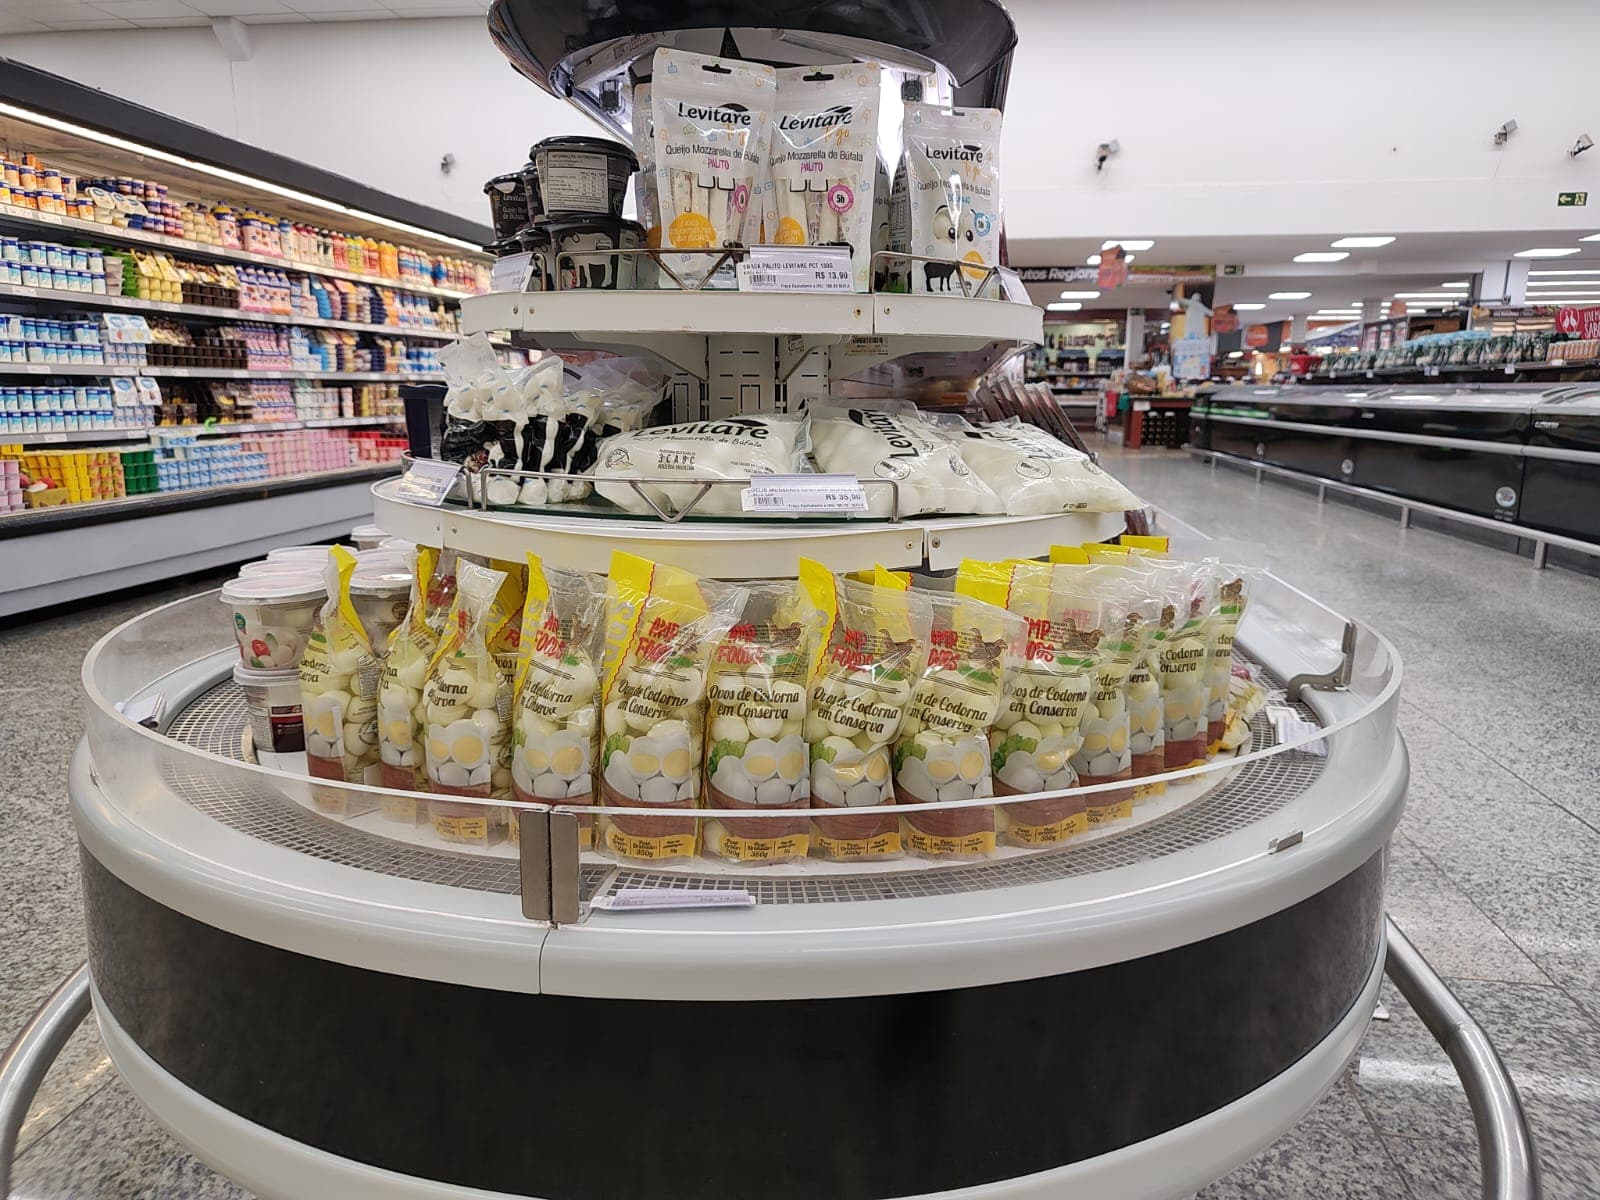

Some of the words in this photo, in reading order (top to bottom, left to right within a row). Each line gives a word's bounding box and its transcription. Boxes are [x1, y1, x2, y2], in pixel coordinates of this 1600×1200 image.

[678, 102, 750, 126] Levitare
[780, 106, 852, 130] Levitare
[665, 144, 691, 155] Queijo
[692, 145, 732, 157] Mozzarella
[788, 150, 827, 161] Mozzarella
[828, 150, 838, 160] de
[926, 145, 984, 163] Levitare
[708, 158, 730, 170] PALITO
[801, 162, 823, 174] PALITO
[815, 271, 826, 280] R$
[1018, 268, 1048, 280] utos
[632, 418, 770, 440] Levitare
[1165, 647, 1204, 661] Codorna
[642, 685, 689, 707] Codorna
[709, 685, 735, 700] Ovos
[736, 688, 752, 701] de
[753, 688, 800, 703] Codorna
[1028, 686, 1044, 699] de
[1045, 686, 1087, 702] Codorna
[717, 704, 734, 717] em
[736, 702, 789, 720] Conserva
[850, 697, 898, 720] Codorna
[923, 693, 938, 708] de
[939, 696, 988, 721] Codorna
[1009, 701, 1027, 713] em
[1029, 700, 1079, 717] Conserva
[817, 707, 833, 721] em
[833, 709, 885, 734] Conserva
[920, 707, 973, 733] Conserva
[636, 849, 654, 858] 350g
